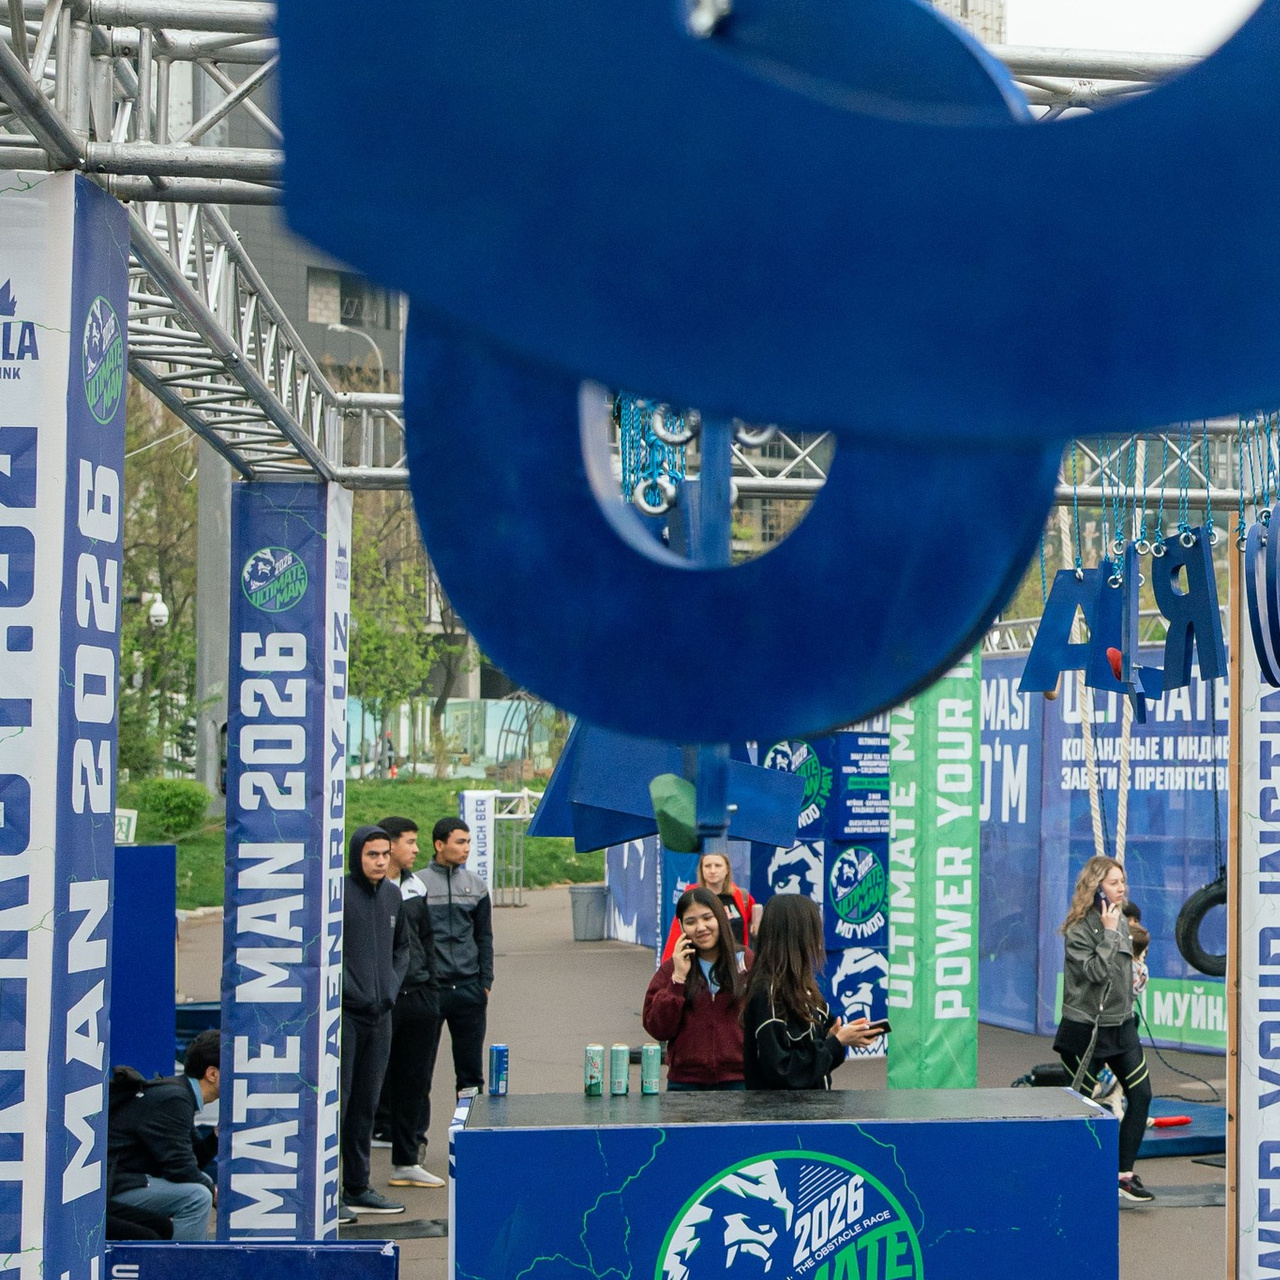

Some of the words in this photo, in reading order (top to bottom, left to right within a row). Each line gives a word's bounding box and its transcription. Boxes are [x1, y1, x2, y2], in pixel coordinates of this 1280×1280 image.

[251, 567, 306, 606] ULTIMATE
[275, 579, 306, 609] MAN
[73, 458, 121, 815] 2026
[239, 632, 307, 811] 2026
[1063, 665, 1229, 724] ULATE
[890, 698, 915, 761] MA
[1163, 736, 1174, 760] И
[936, 697, 973, 827] YOUR
[475, 799, 486, 821] BER
[476, 825, 487, 857] KUCH
[235, 843, 305, 1003] MAN
[837, 867, 884, 916] ULTIMATE
[858, 883, 884, 919] MAN
[889, 781, 916, 1009] ULTIMATE
[933, 846, 973, 1021] POWER
[1153, 986, 1227, 1031] МУЙН
[61, 879, 110, 1205] MAN
[793, 1174, 865, 1268] 2026
[795, 1255, 816, 1275] THE
[814, 1222, 863, 1260] OBSTACLE
[863, 1209, 892, 1229] RACE
